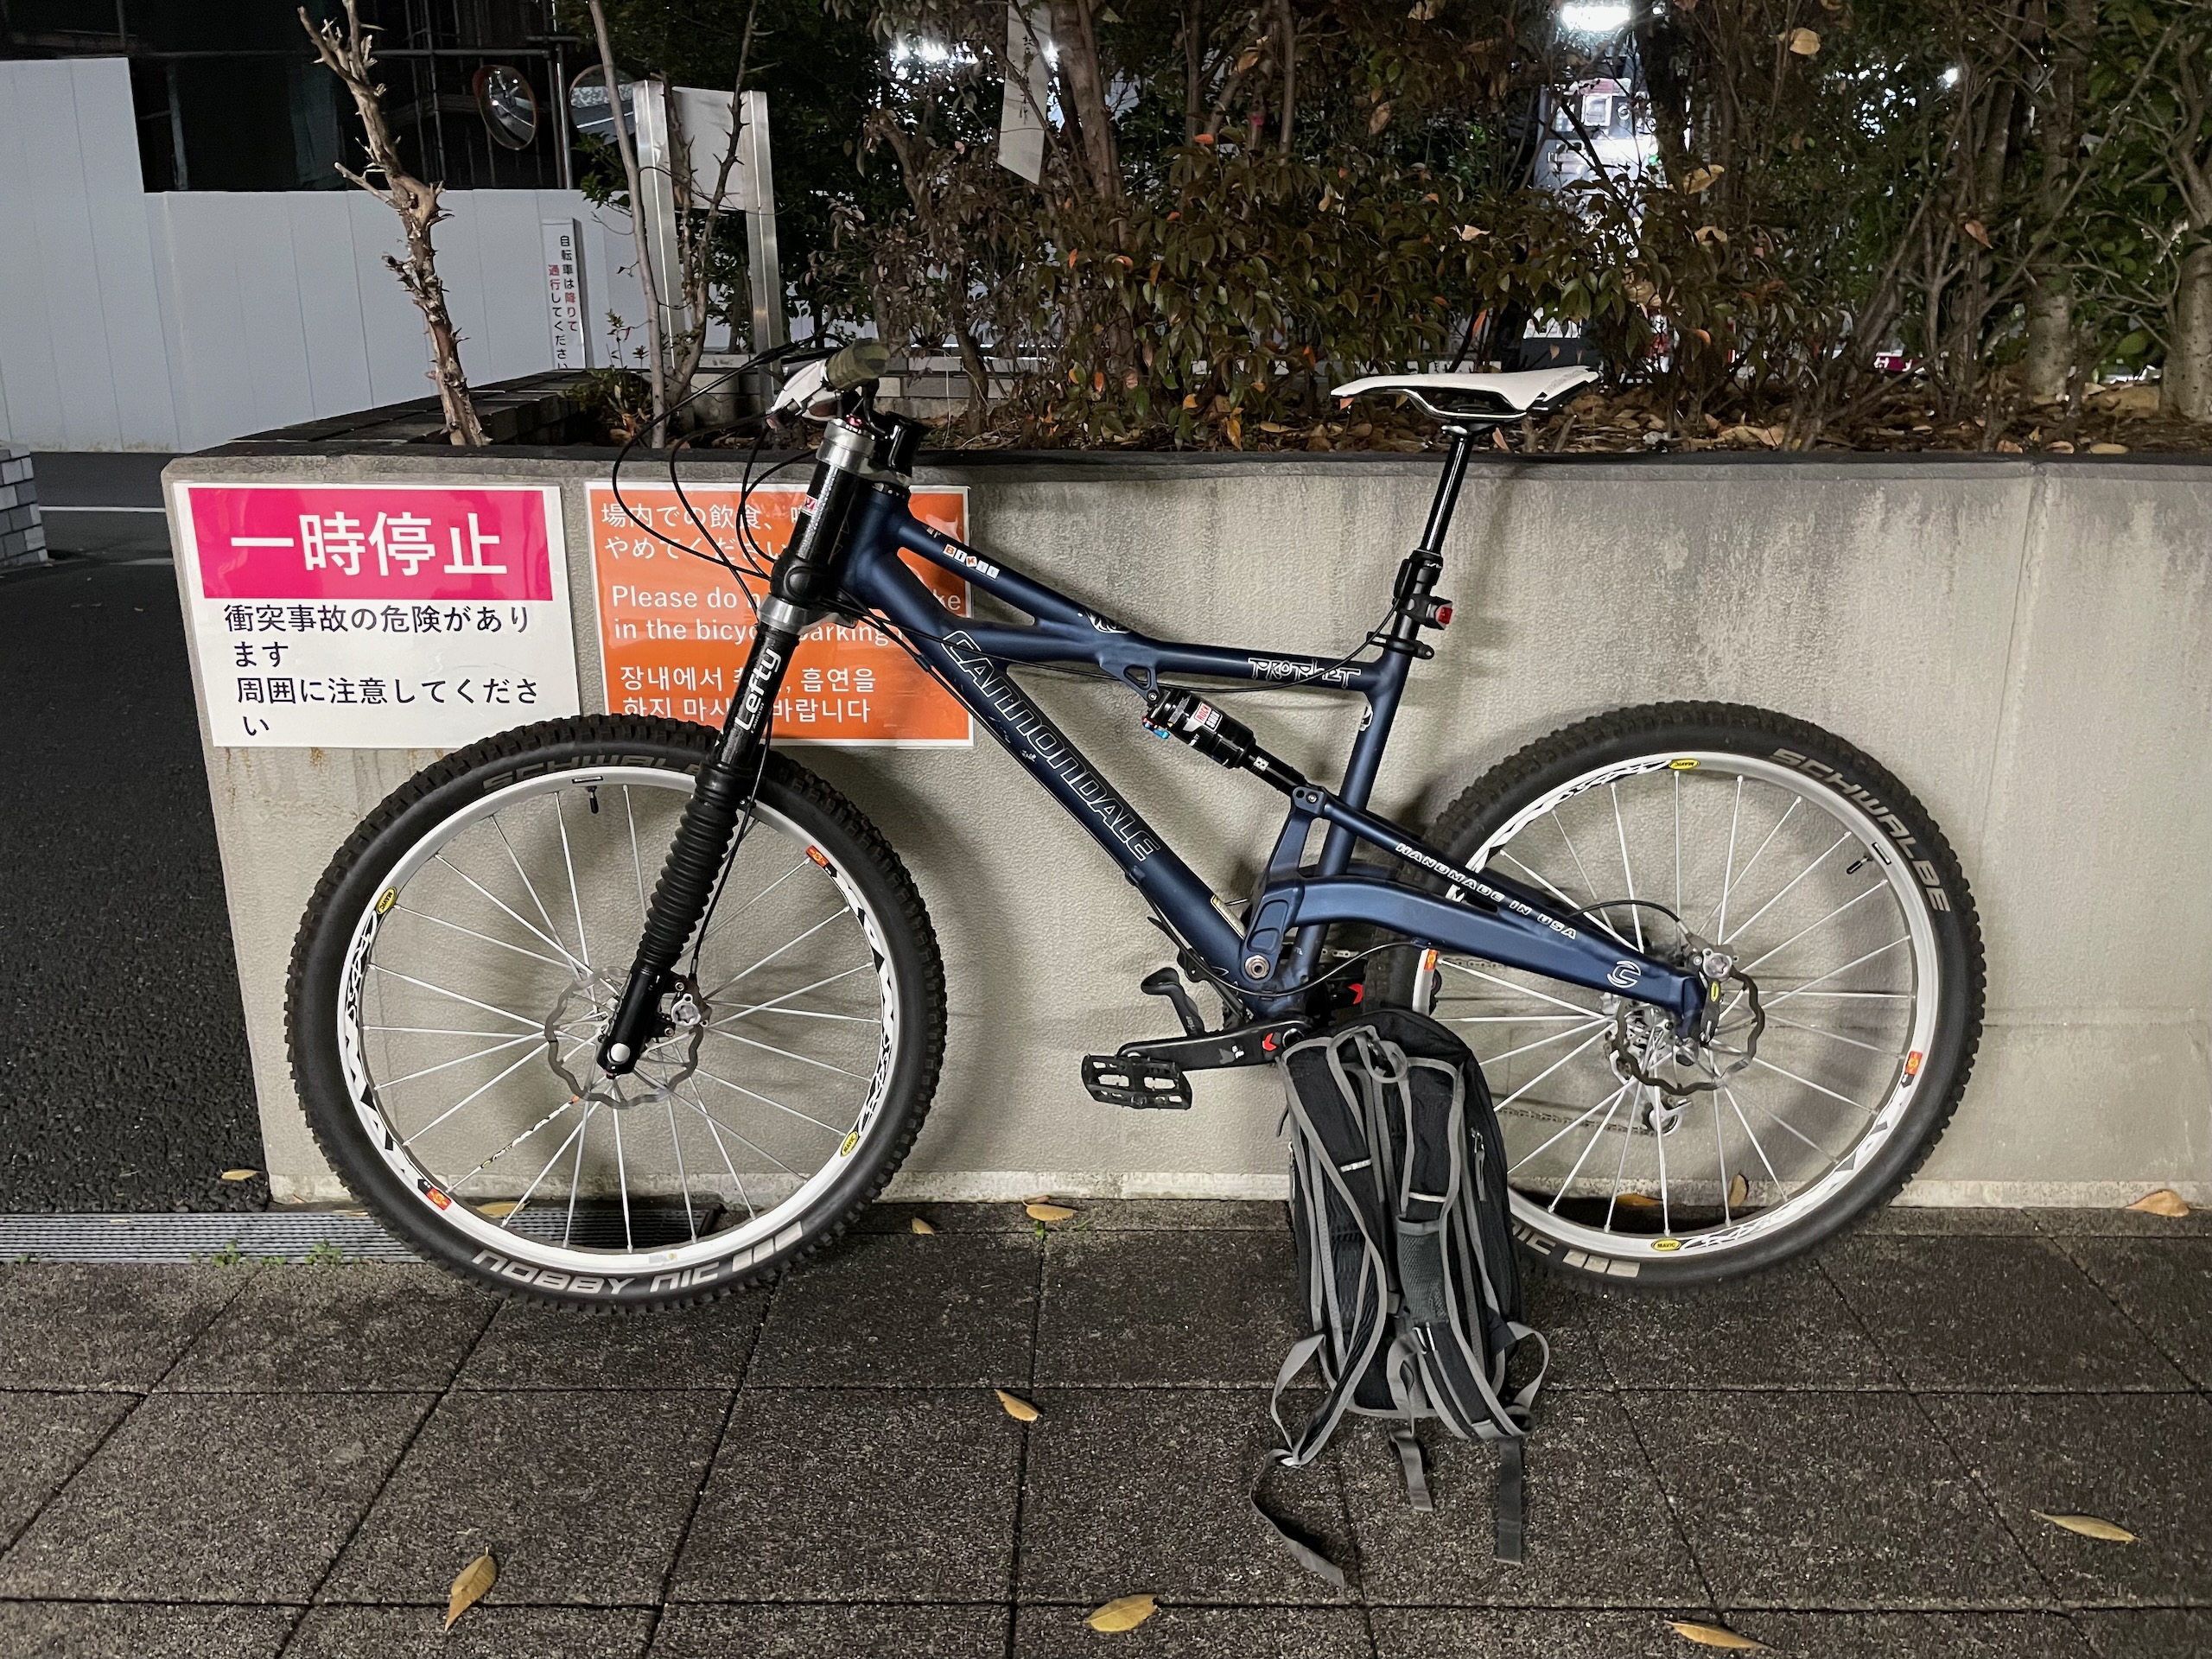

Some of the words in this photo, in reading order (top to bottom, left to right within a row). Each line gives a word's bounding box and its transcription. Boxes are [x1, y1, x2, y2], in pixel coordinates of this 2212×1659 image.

[560, 235, 577, 331] 自転車は降りて
[231, 511, 508, 576] 一時停止
[612, 585, 698, 608] Please
[707, 586, 738, 608] do
[224, 603, 529, 633] 衝突事故の危険があり
[614, 618, 637, 640] in
[645, 618, 687, 641] the
[233, 640, 289, 668] ます
[237, 677, 538, 705] 周囲に注意してくださ
[620, 665, 722, 692] 장내에서
[800, 667, 876, 693] 흡연을
[734, 647, 782, 731] Lefty
[622, 696, 672, 718] 하지
[772, 697, 871, 723] 바랍니다
[242, 715, 270, 736] い
[1769, 747, 1951, 912] SCHWALBE
[1395, 842, 1505, 902] HANDMADE
[1509, 899, 1533, 917] IN
[1537, 912, 1578, 940] USA
[471, 1249, 636, 1295] NOBBY
[649, 1261, 720, 1294] NIC
